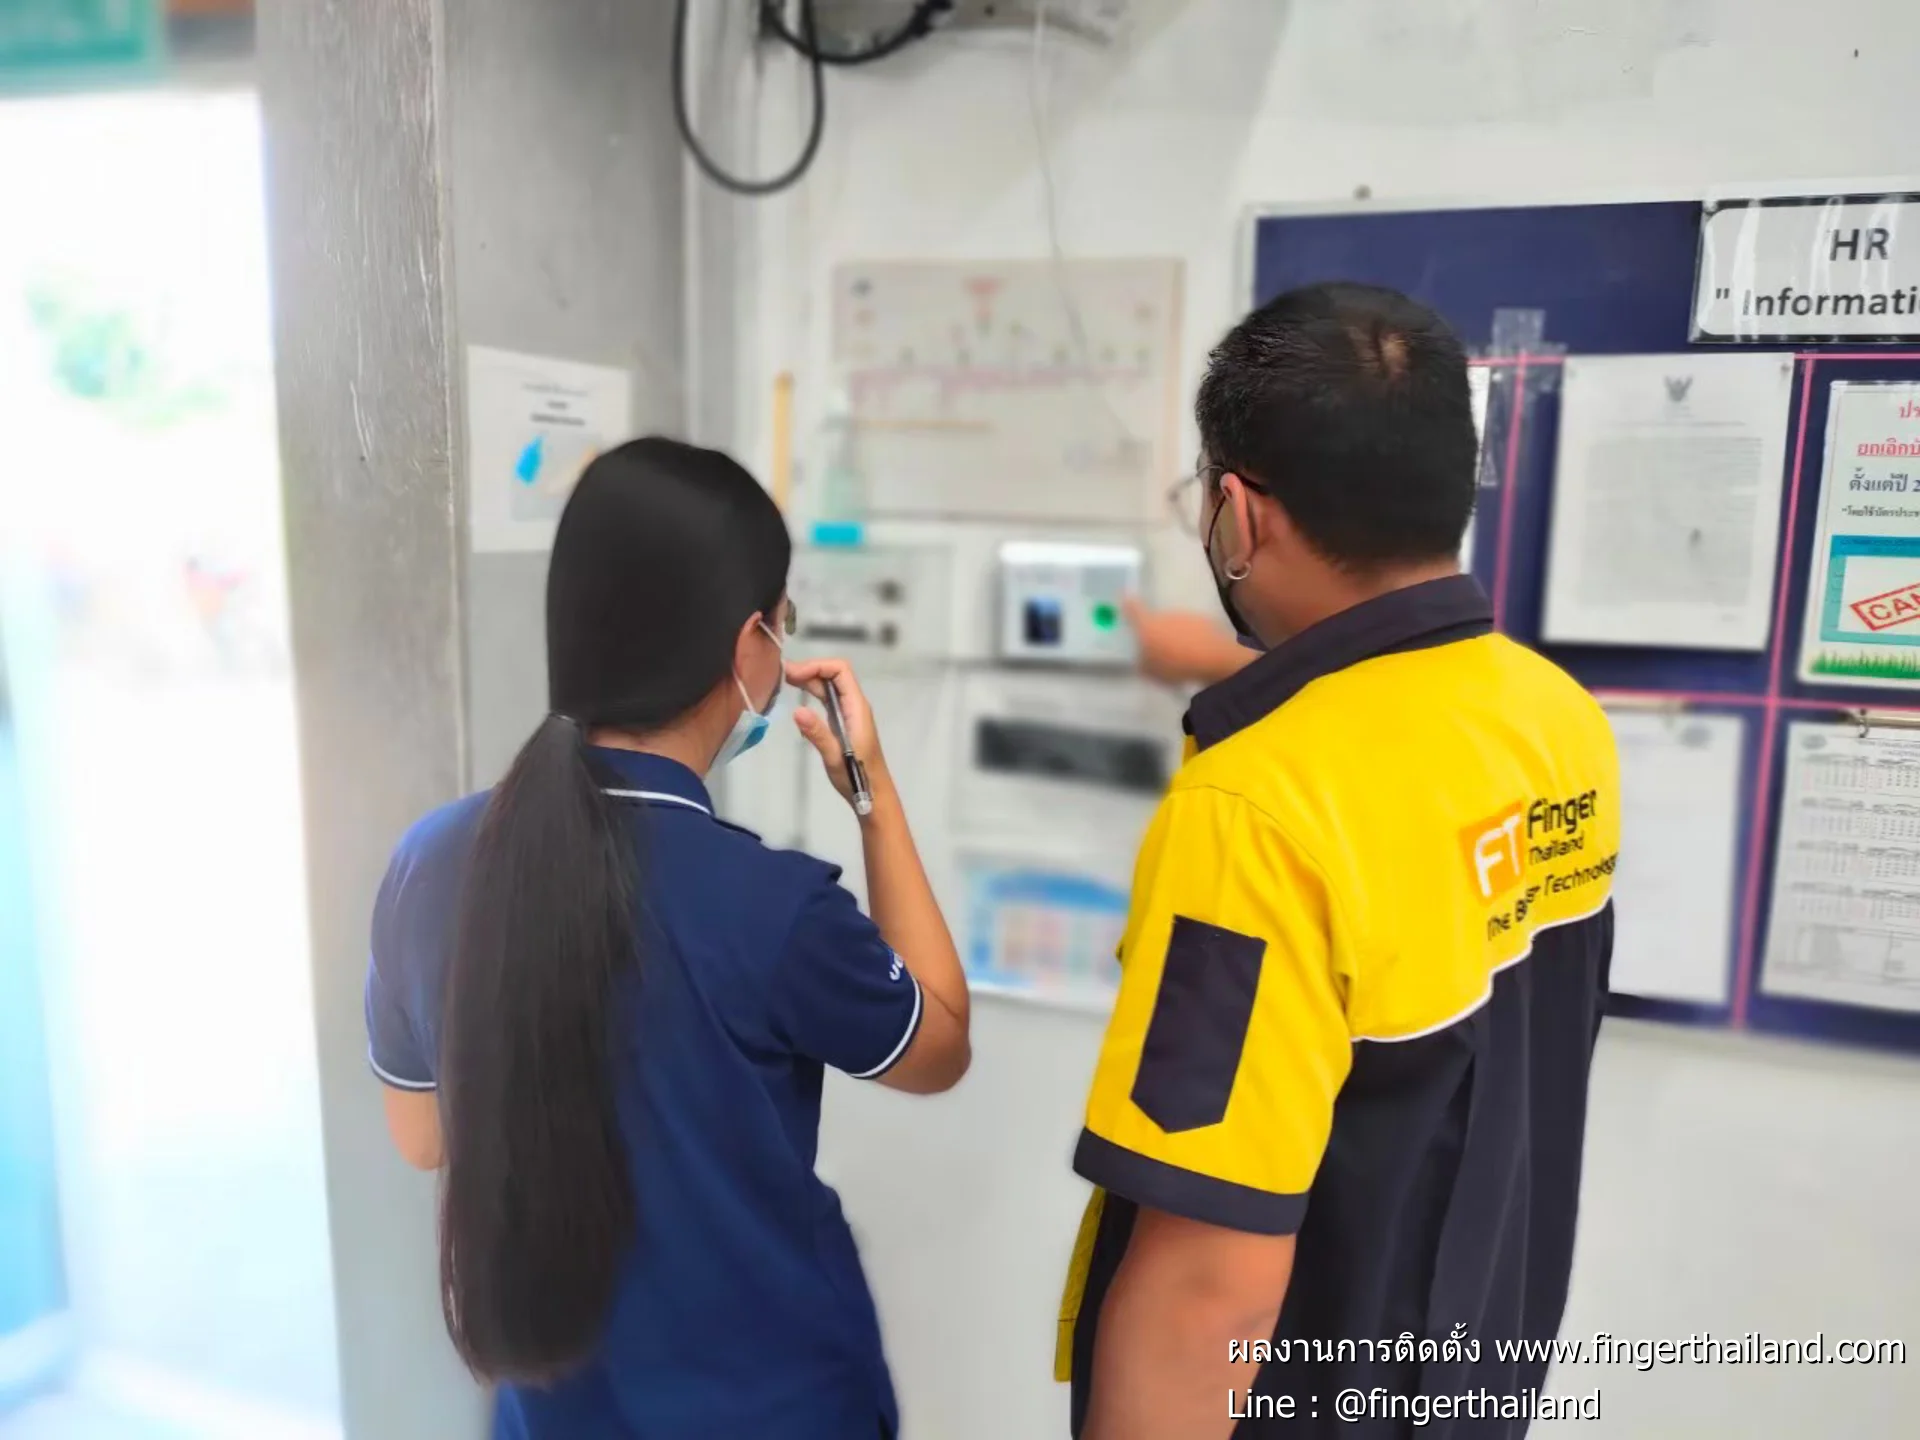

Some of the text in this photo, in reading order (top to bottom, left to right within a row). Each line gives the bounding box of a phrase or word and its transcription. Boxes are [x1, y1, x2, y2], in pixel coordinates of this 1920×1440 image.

[1829, 228, 1889, 261] HR
[1743, 286, 1920, 316] Informati
[1474, 813, 1521, 897] FT
